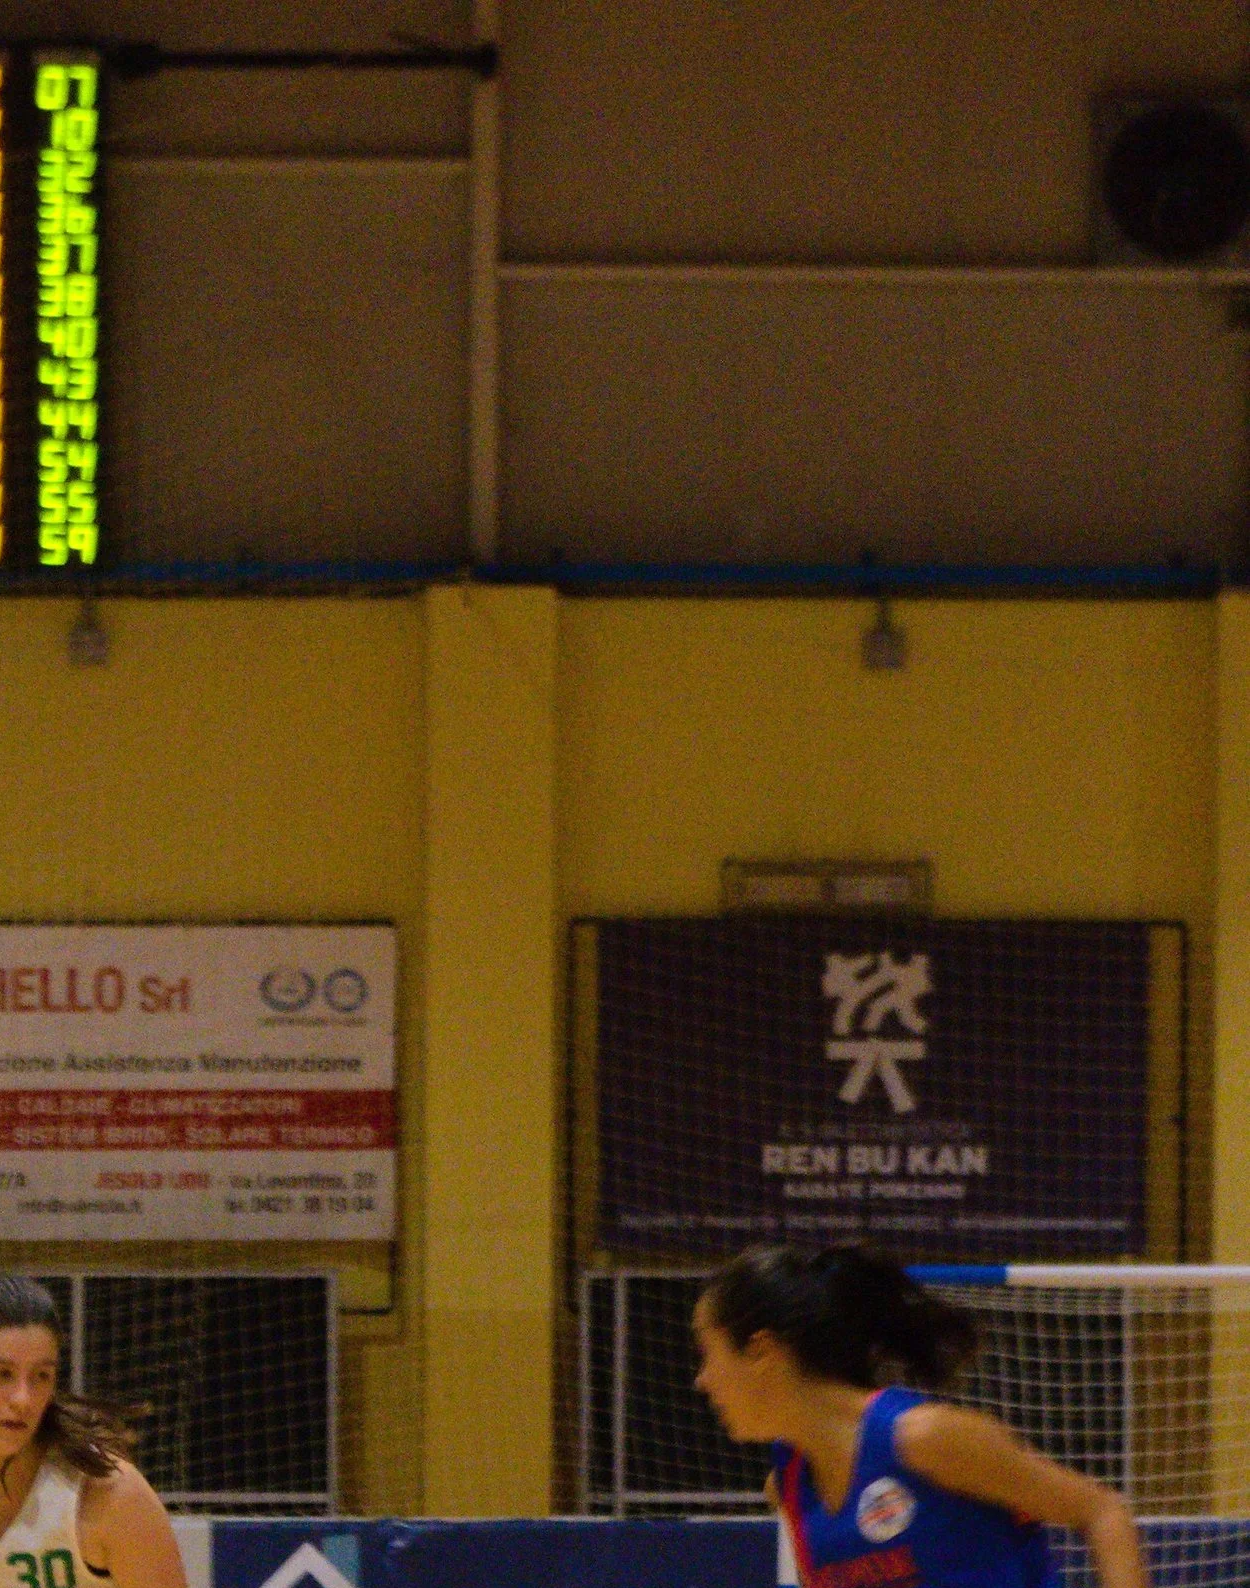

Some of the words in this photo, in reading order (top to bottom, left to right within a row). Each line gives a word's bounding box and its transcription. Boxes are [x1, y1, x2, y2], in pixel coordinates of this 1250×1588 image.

[139, 976, 192, 1014] Srl
[63, 1054, 192, 1073] Assistenza
[199, 1055, 363, 1073] Manutenzione
[762, 1144, 839, 1176] REN
[847, 1144, 901, 1176] BU
[907, 1144, 989, 1176] KAN
